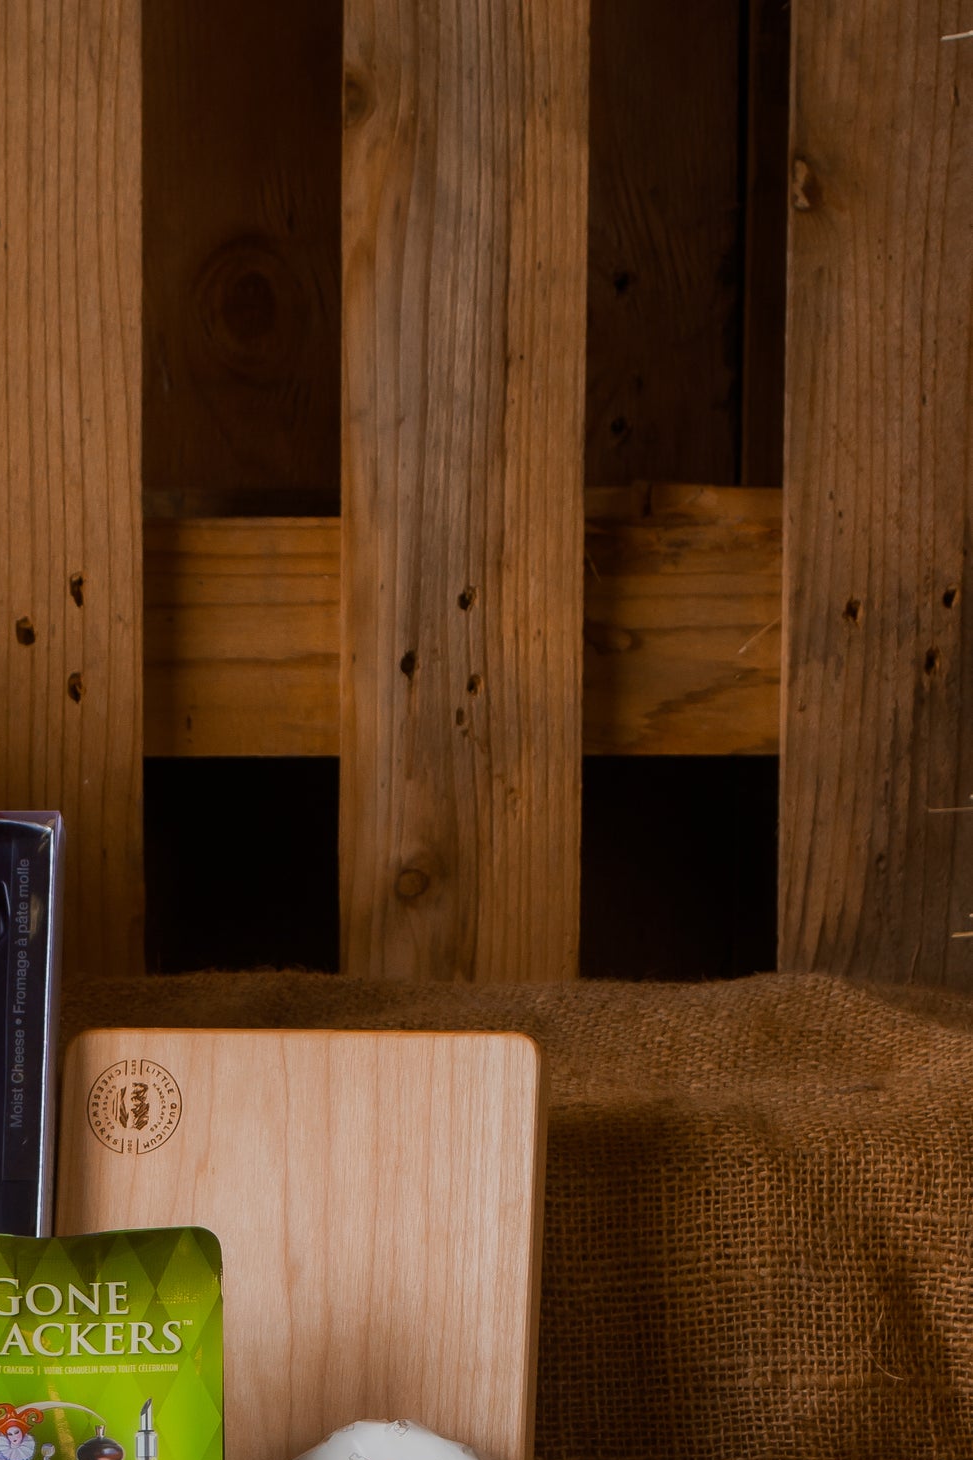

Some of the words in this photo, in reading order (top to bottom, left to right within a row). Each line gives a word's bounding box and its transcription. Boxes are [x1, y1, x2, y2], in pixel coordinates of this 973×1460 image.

[17, 857, 30, 898] molle
[15, 903, 30, 935] pâte
[13, 950, 30, 1015] Fromage
[11, 1030, 25, 1083] Cheese
[146, 1066, 175, 1094] LITTLE
[11, 1088, 23, 1128] Moist
[91, 1069, 122, 1145] CHEESEWORKS
[143, 1102, 178, 1149] QUALICUM
[3, 1365, 34, 1375] CRACKERS
[65, 1365, 98, 1375] CRAQUELIN
[99, 1365, 117, 1374] POUR
